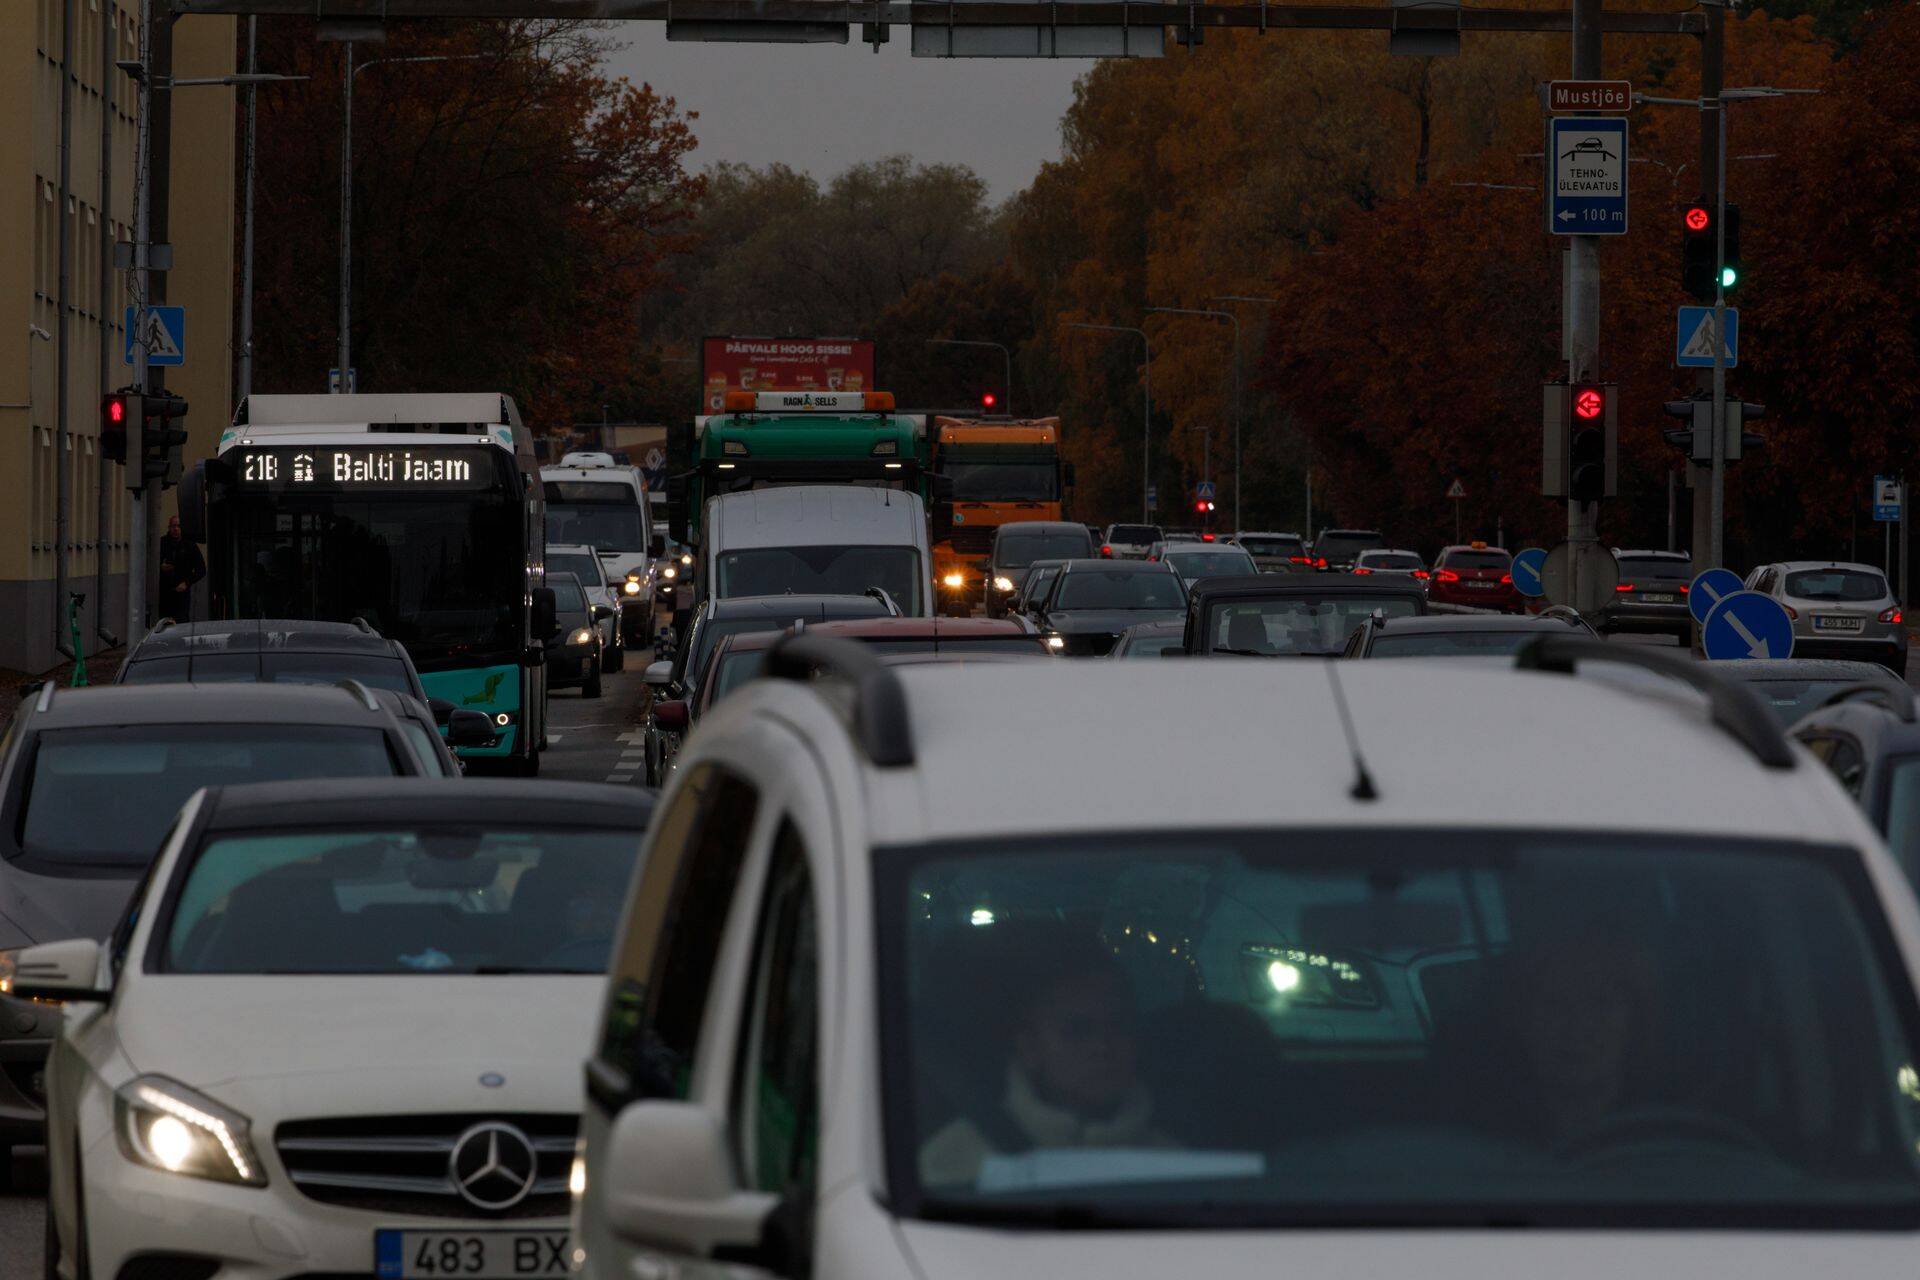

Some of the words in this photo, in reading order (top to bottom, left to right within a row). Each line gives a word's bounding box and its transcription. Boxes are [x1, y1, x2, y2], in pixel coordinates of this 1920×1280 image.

[1556, 88, 1624, 107] Mustjõe
[1570, 168, 1608, 178] TEHNO-
[1559, 179, 1618, 191] ÜLEVAATUS
[1582, 208, 1607, 221] 100
[1611, 210, 1623, 221] m
[726, 342, 777, 354] PÄEVALE
[780, 344, 815, 354] HOOG
[816, 345, 852, 355] SISSE!
[783, 396, 803, 406] RAGN
[815, 396, 837, 406] SELLS
[334, 453, 393, 481] Balti
[404, 453, 470, 481] jaam
[416, 1238, 484, 1273] 483
